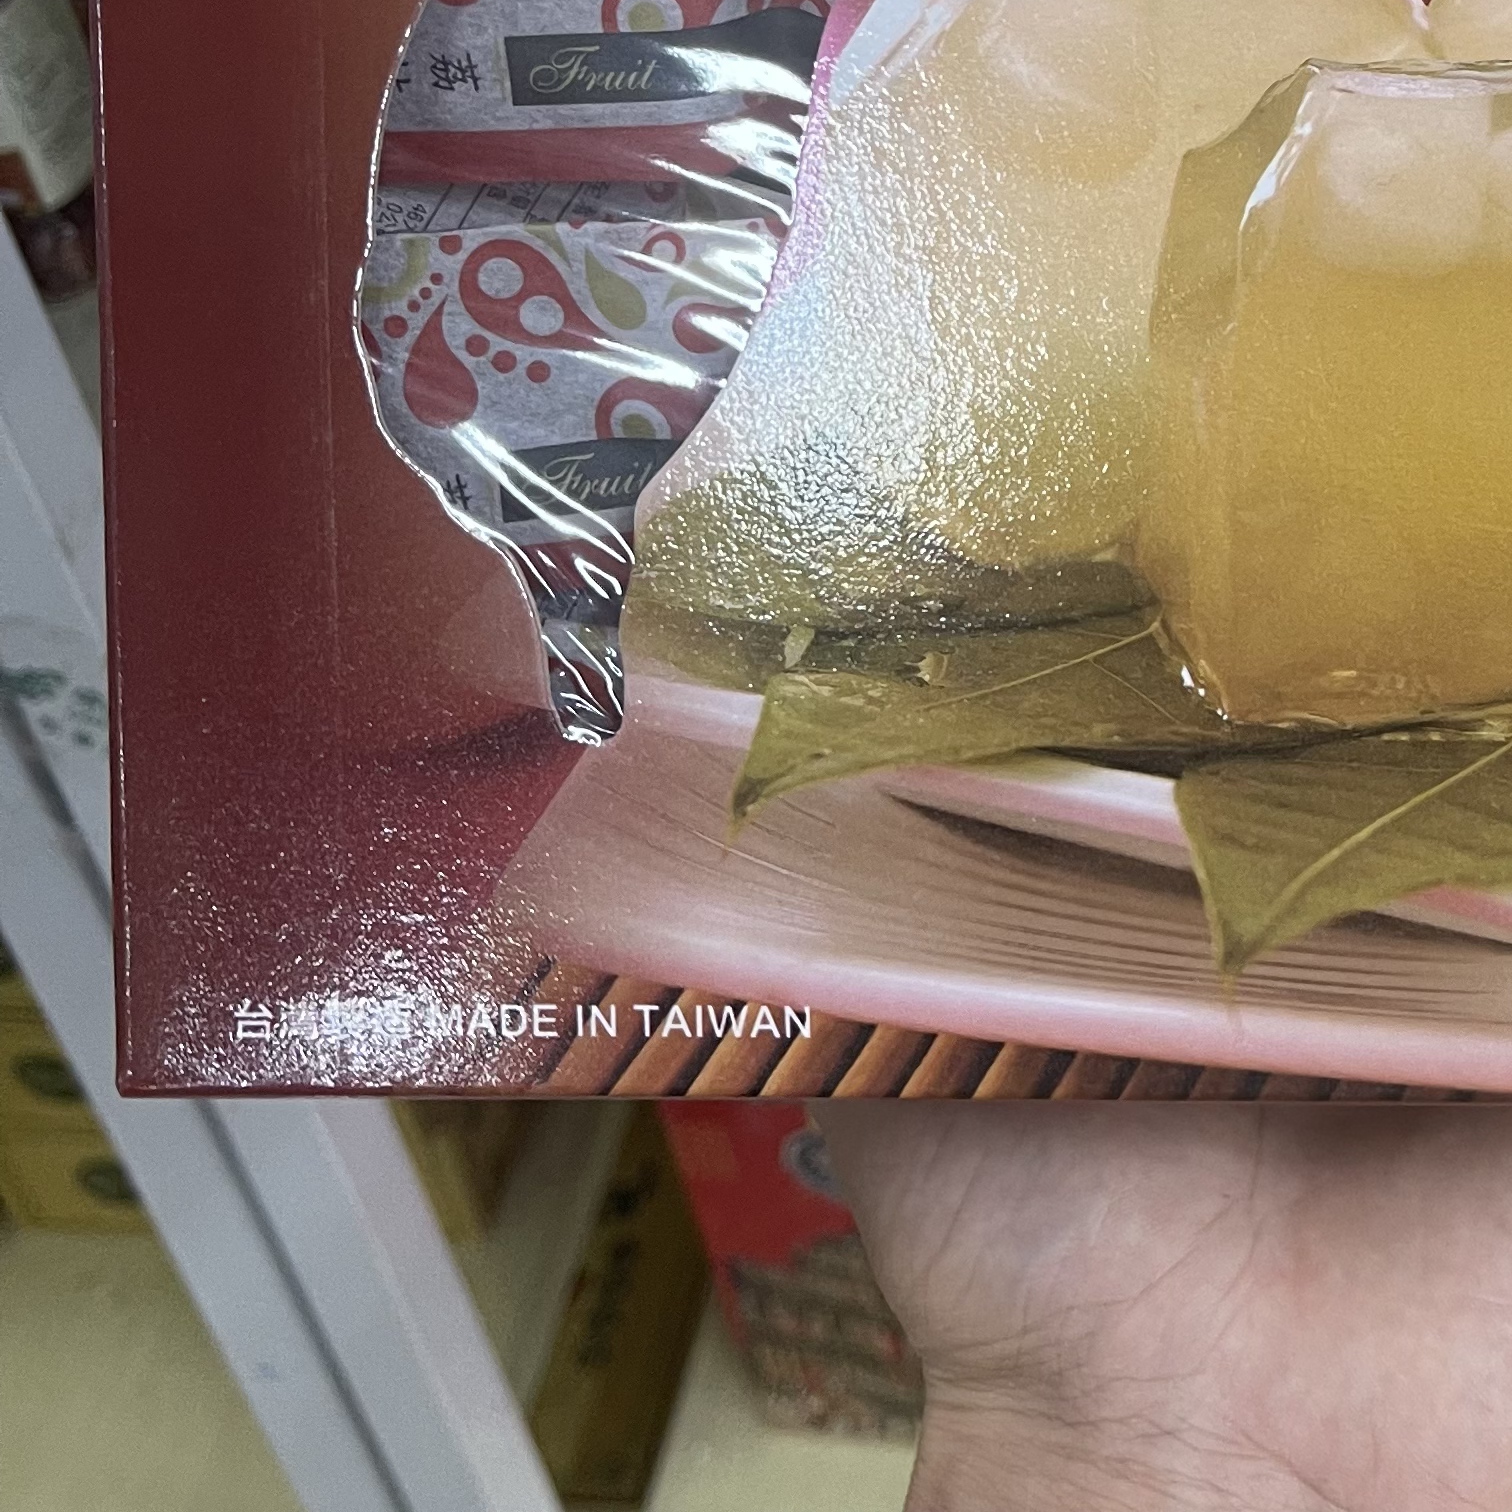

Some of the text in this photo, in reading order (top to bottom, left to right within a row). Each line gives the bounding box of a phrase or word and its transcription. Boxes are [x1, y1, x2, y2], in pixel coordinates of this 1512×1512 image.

[529, 45, 657, 94] Fruit
[428, 1003, 811, 1040] MADE IN TAIWAN
